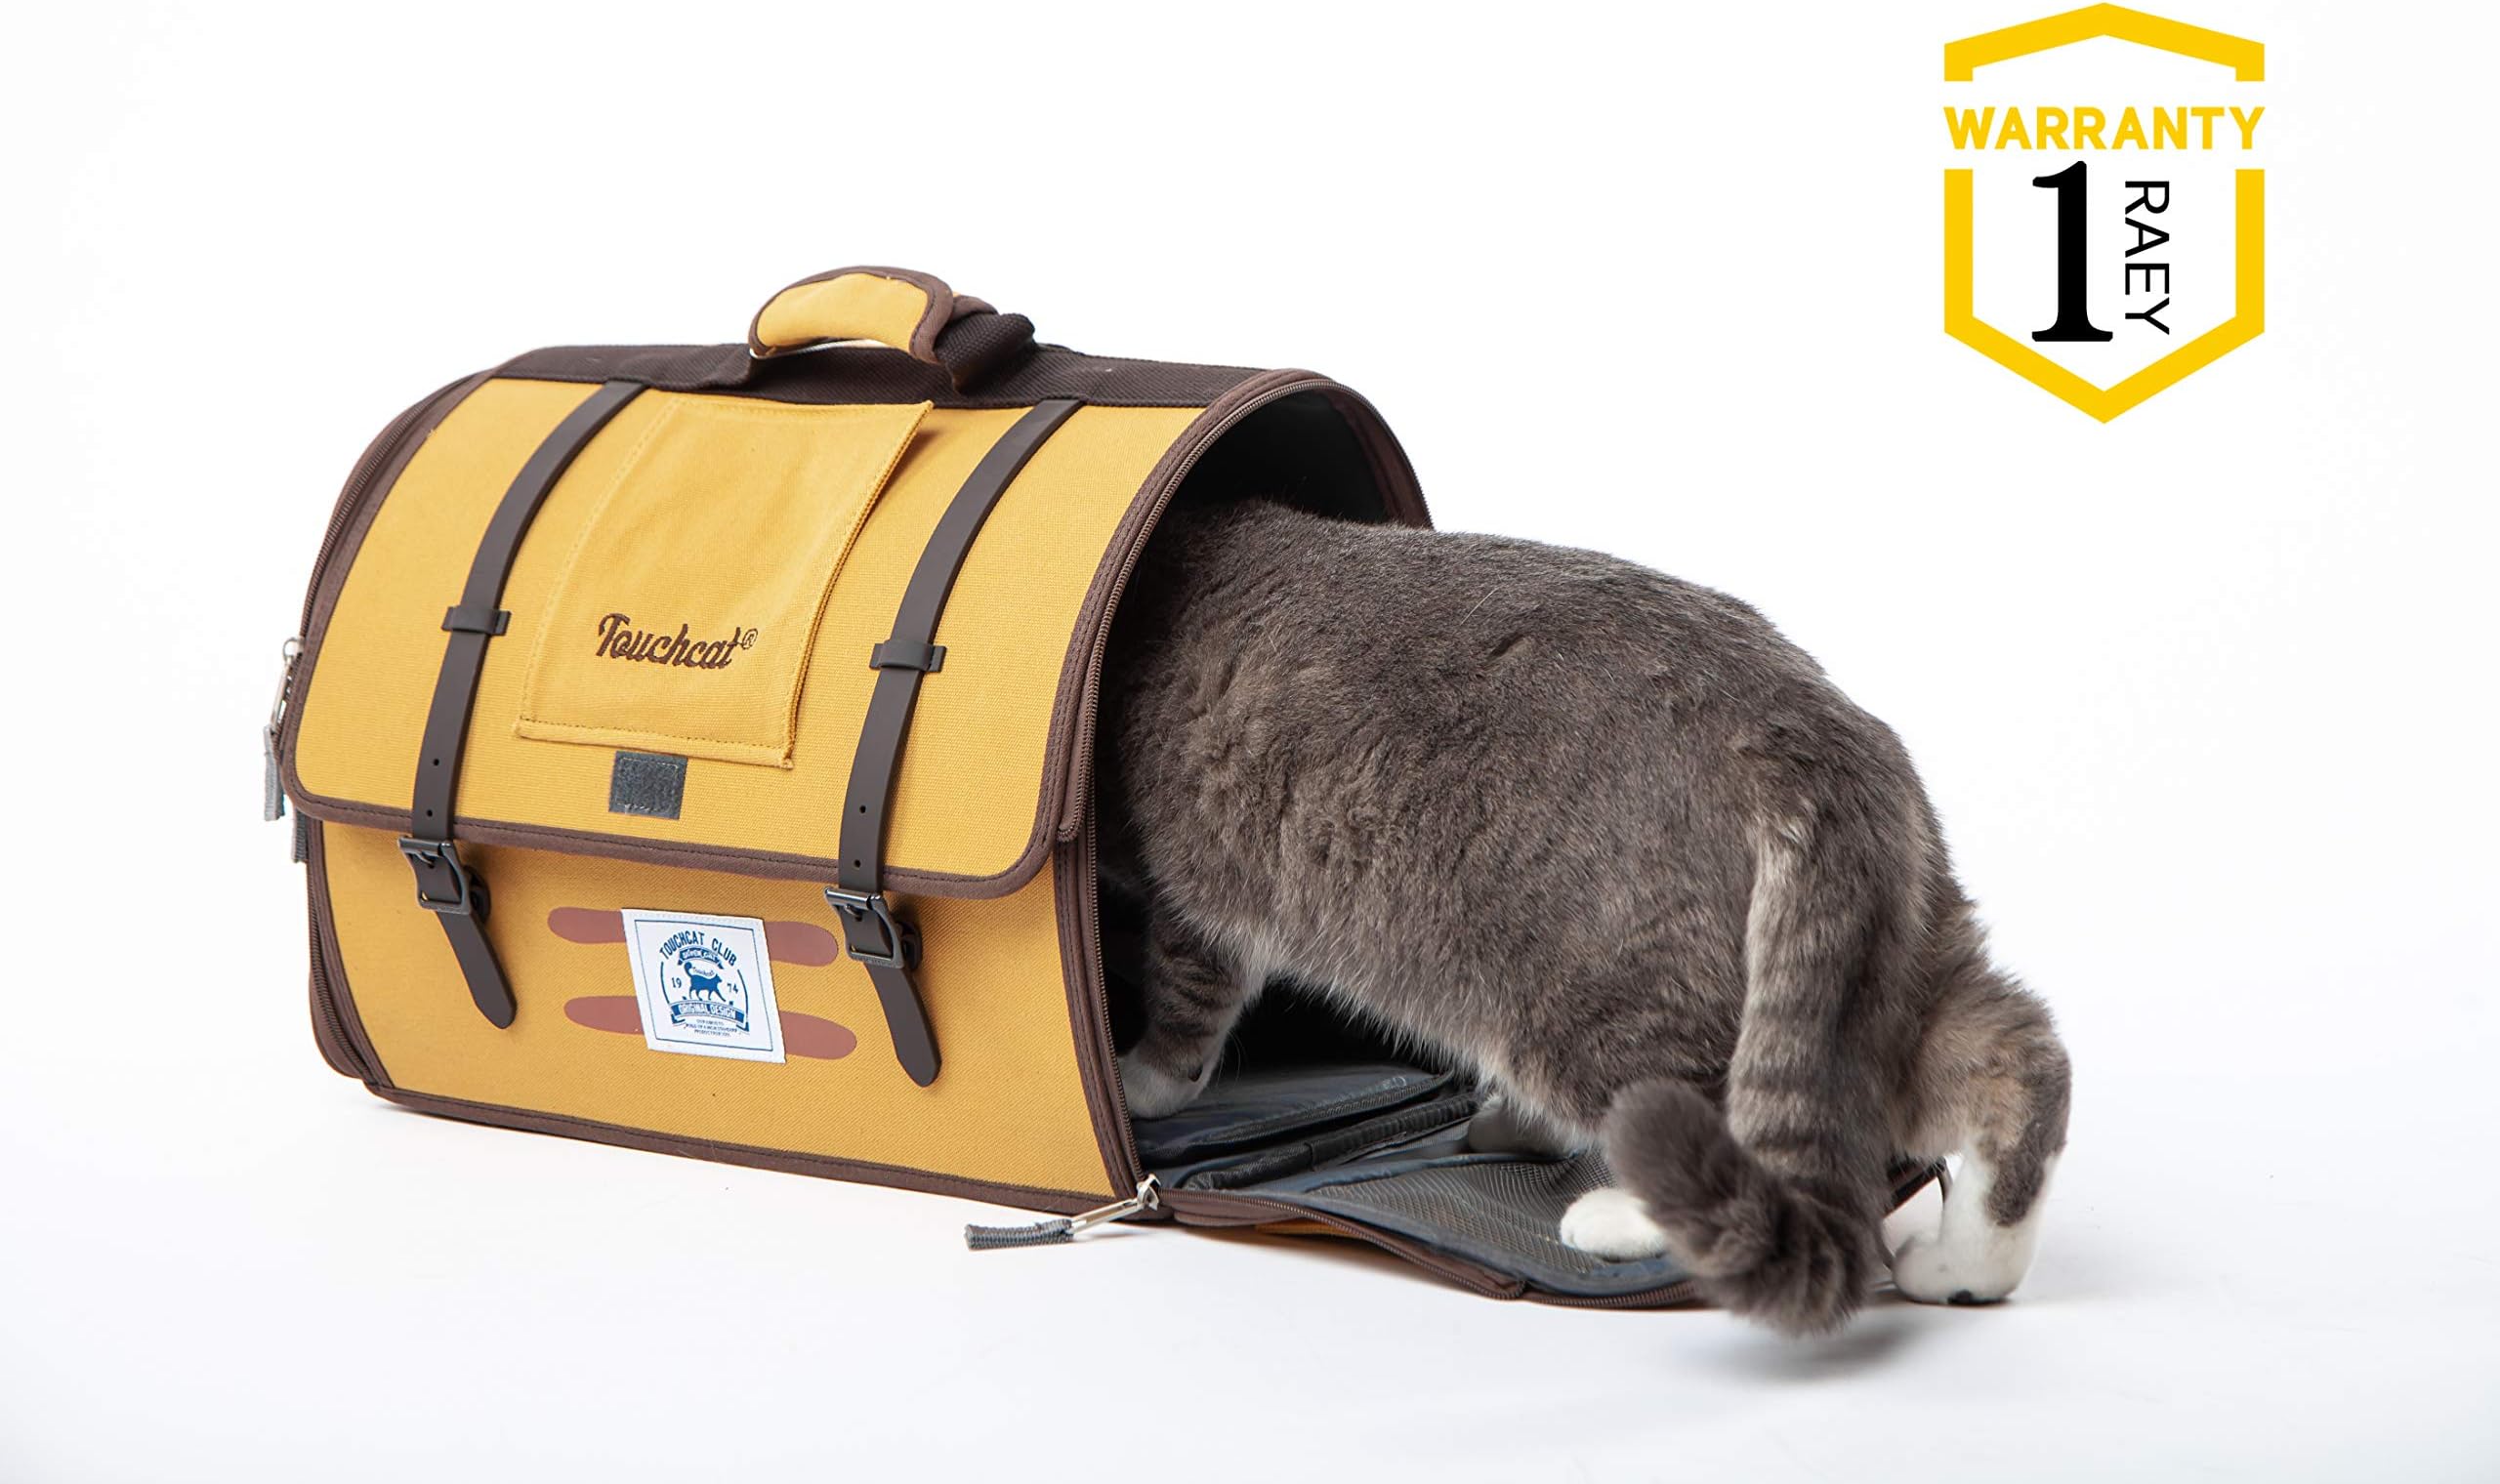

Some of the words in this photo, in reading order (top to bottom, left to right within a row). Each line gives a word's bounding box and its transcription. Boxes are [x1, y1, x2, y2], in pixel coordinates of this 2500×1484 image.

[659, 930, 705, 960] TOUCHCAT
[712, 938, 737, 967] CLUB
[671, 977, 682, 989] 19
[727, 983, 739, 995] 74
[679, 1003, 710, 1016] ORIGINAL
[710, 1006, 736, 1019] DESIGN
